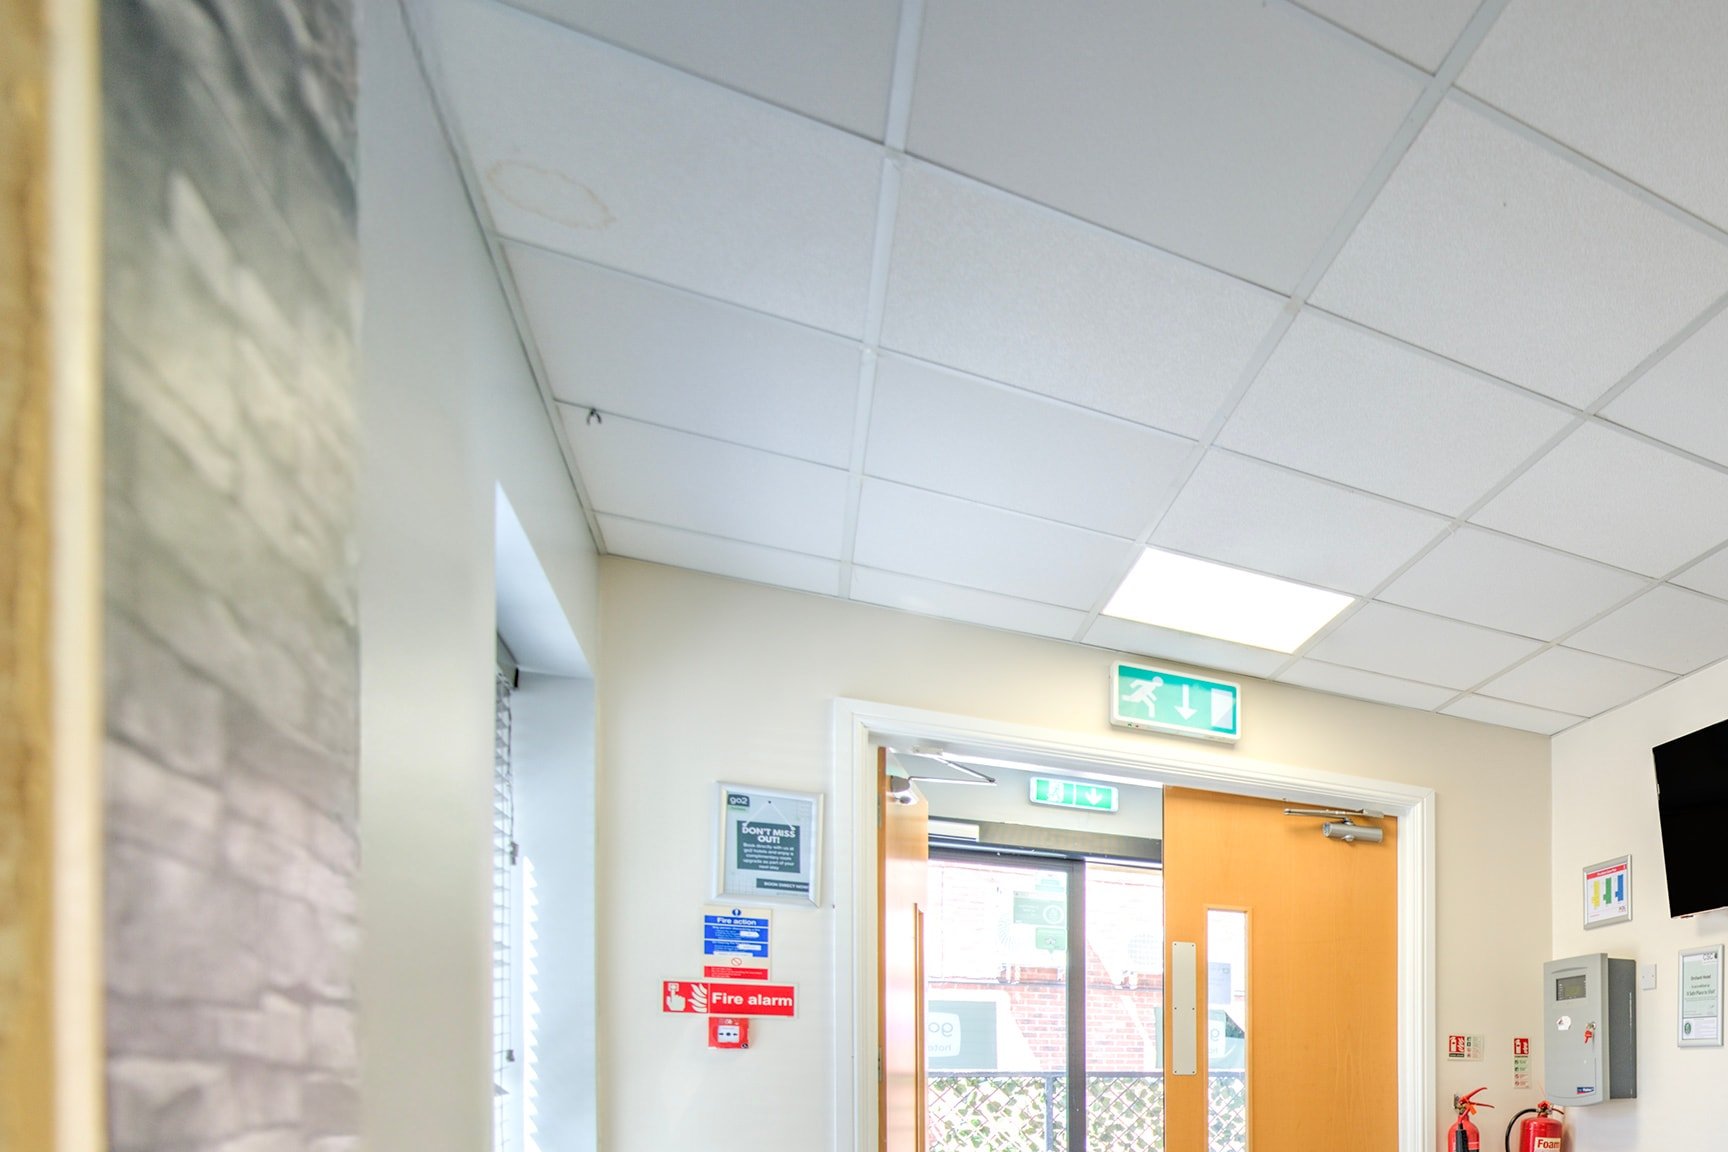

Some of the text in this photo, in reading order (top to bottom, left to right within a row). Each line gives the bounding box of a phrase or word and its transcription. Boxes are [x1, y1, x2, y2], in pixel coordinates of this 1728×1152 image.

[730, 796, 748, 805] go2
[742, 827, 796, 838] DON'T MISS
[758, 835, 780, 844] OUT!
[717, 917, 757, 926] Fire action
[711, 992, 793, 1007] Fire alarm
[1537, 1139, 1560, 1149] Foam
